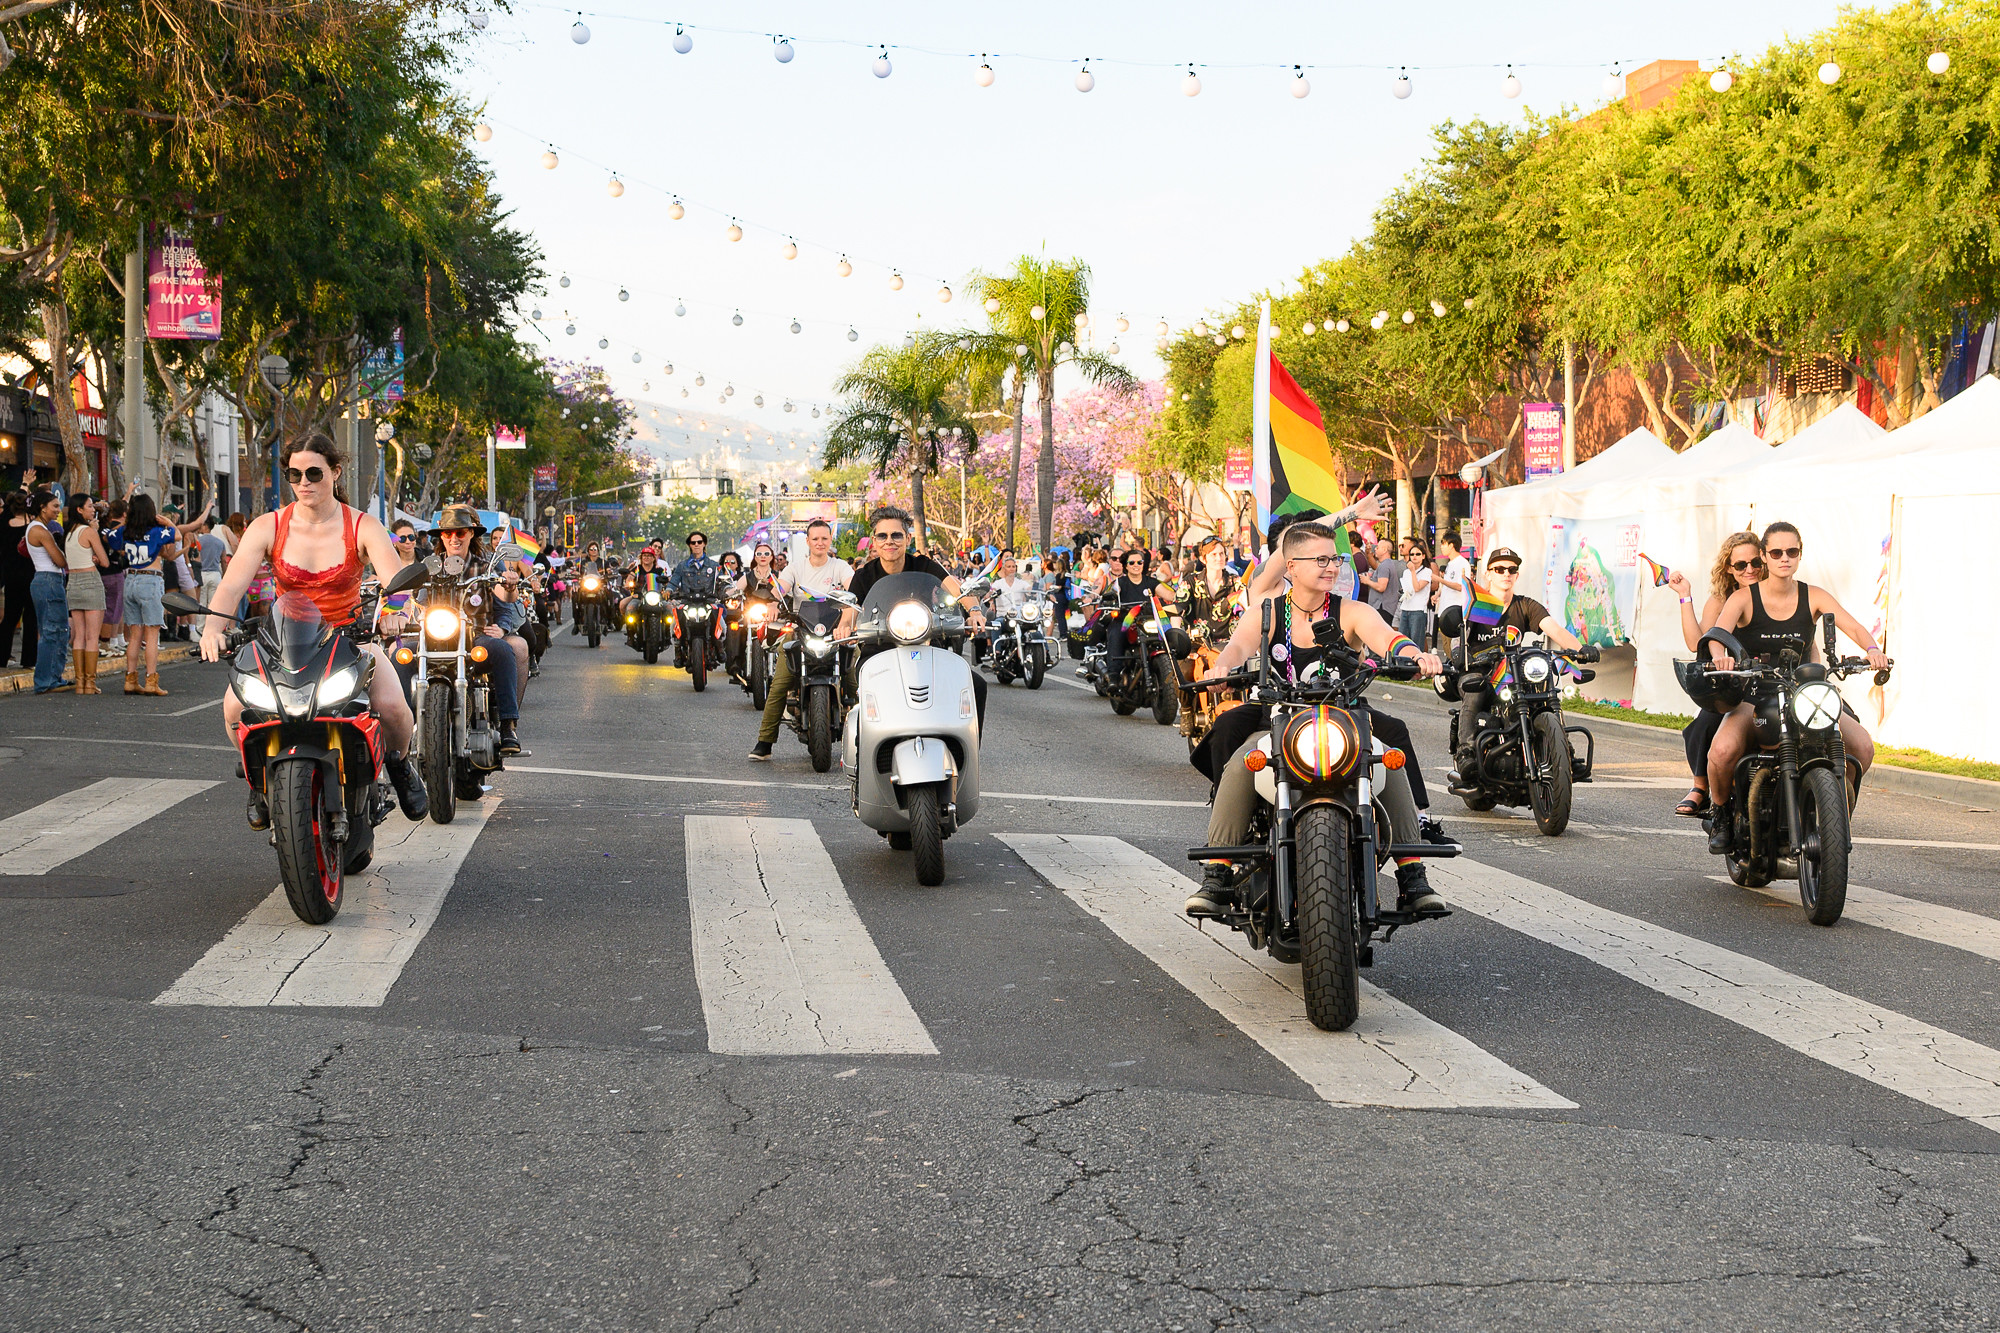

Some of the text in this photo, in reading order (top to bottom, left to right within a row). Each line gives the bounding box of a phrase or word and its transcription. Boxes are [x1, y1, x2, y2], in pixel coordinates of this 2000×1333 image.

[162, 246, 197, 255] WOME
[162, 253, 201, 261] FREEDO
[177, 268, 195, 276] and
[153, 277, 179, 285] DYKE
[160, 293, 195, 305] MAY
[157, 324, 213, 333] wehopride.com
[1527, 411, 1560, 420] WEHO
[1527, 420, 1560, 429] PRIDE
